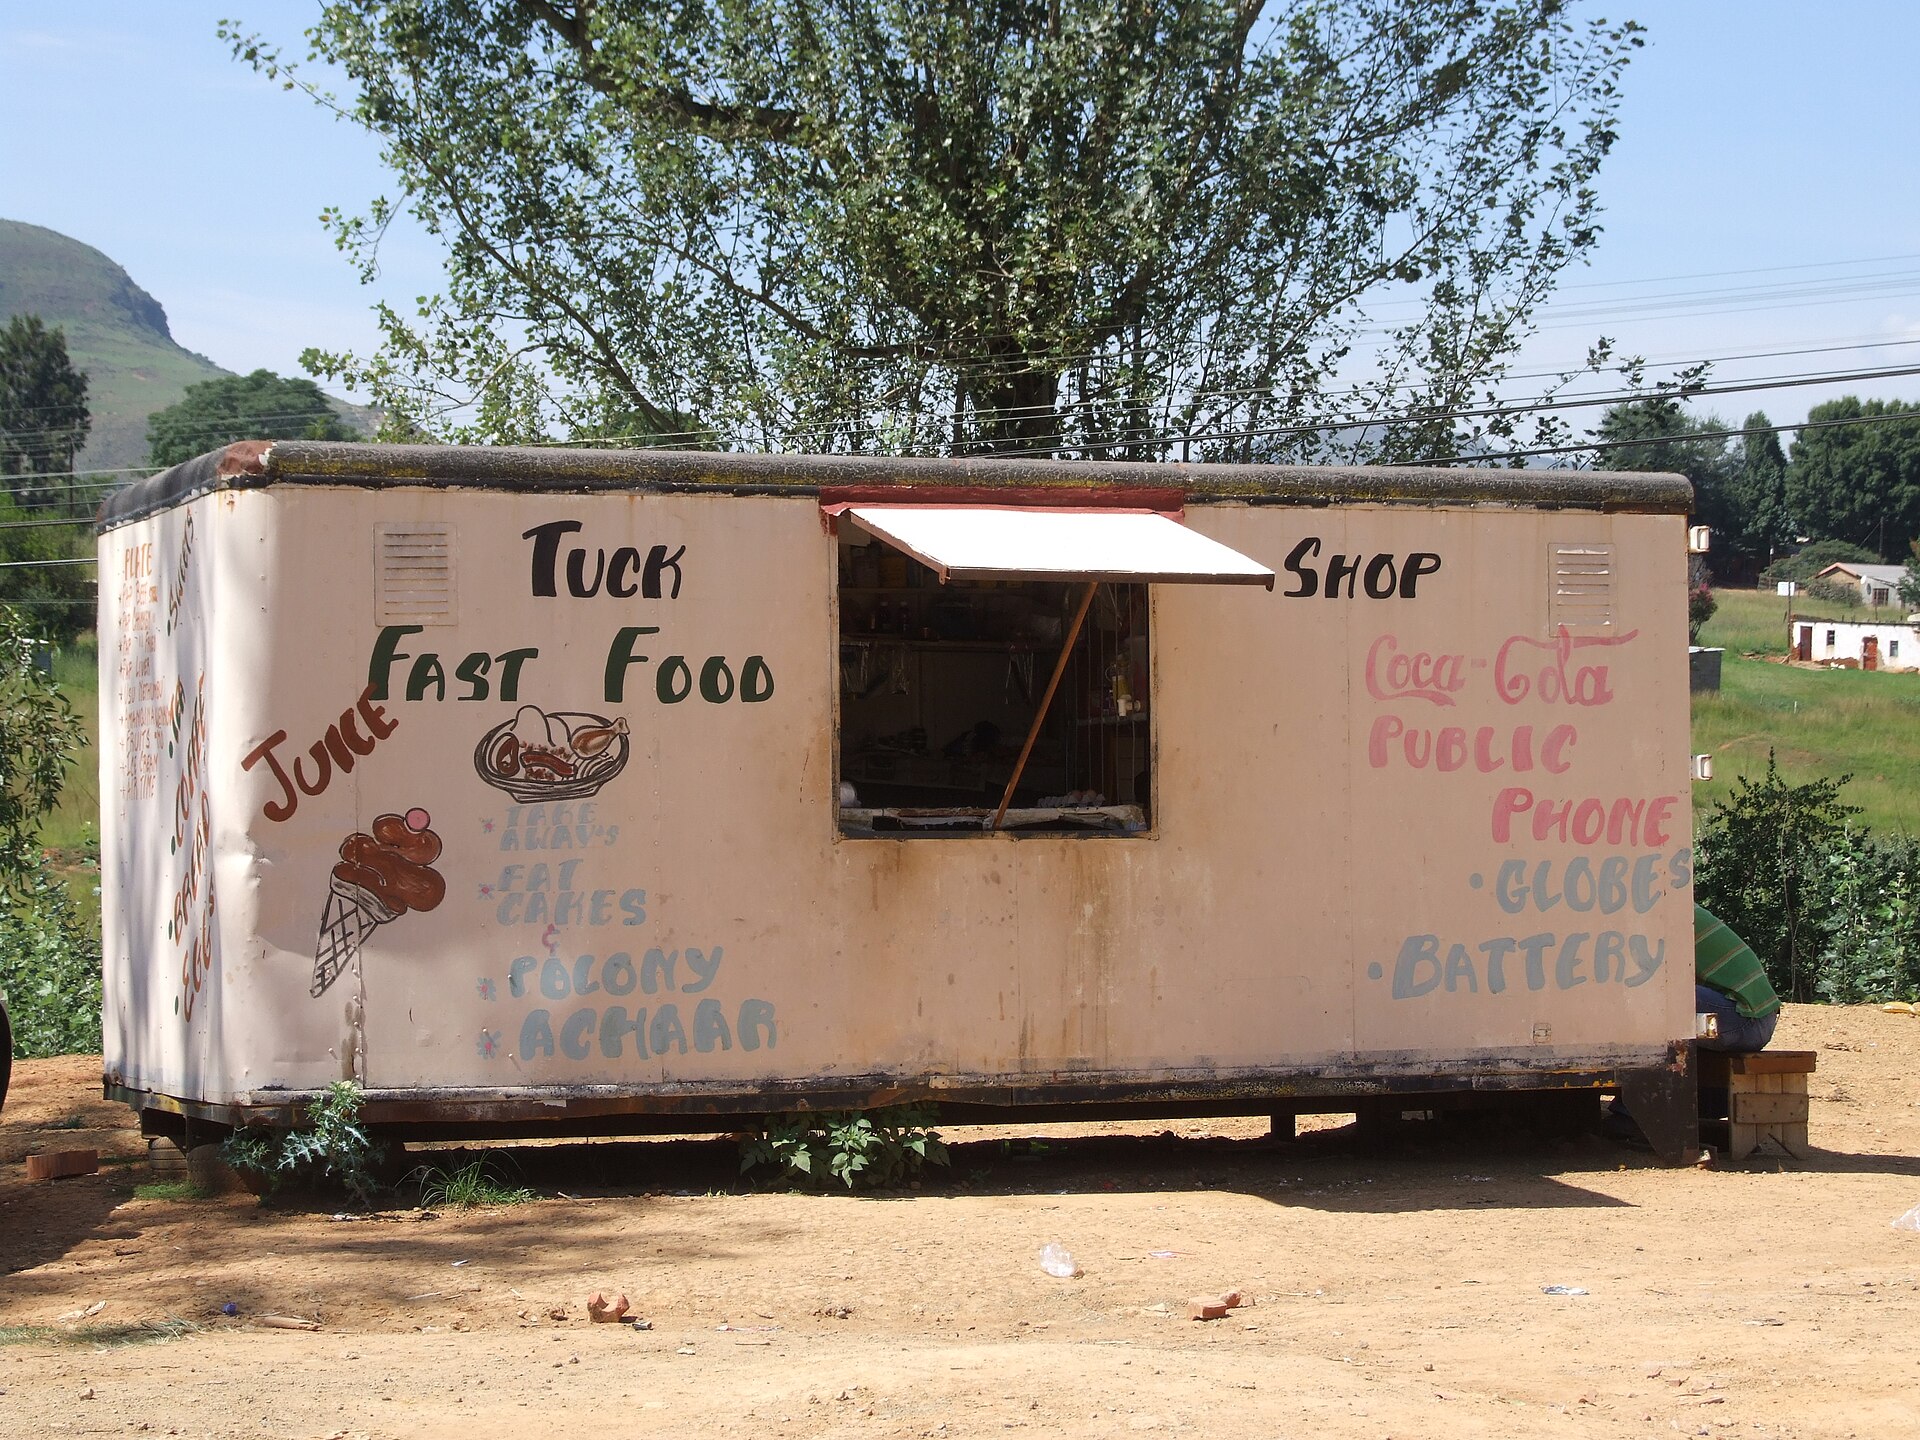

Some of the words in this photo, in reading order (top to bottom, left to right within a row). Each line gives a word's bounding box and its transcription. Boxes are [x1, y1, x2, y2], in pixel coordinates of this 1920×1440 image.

[521, 520, 687, 599] TUCK
[1284, 537, 1442, 599] SHOP
[367, 625, 539, 702] FAST
[604, 626, 776, 704] FOOD
[1365, 624, 1639, 706] Coca-Cola
[241, 683, 399, 822] JUICE
[1368, 714, 1578, 774] PUBLIC
[1491, 787, 1679, 848] PHONE
[174, 790, 210, 947] BREAD
[498, 859, 584, 892] FAT
[1496, 848, 1692, 915] GLOBES
[496, 889, 647, 926] CAKES
[182, 872, 215, 1023] EGGS
[509, 946, 724, 999] POLONY
[1392, 930, 1665, 1000] BATTERY
[519, 998, 777, 1060] ACHAAR
